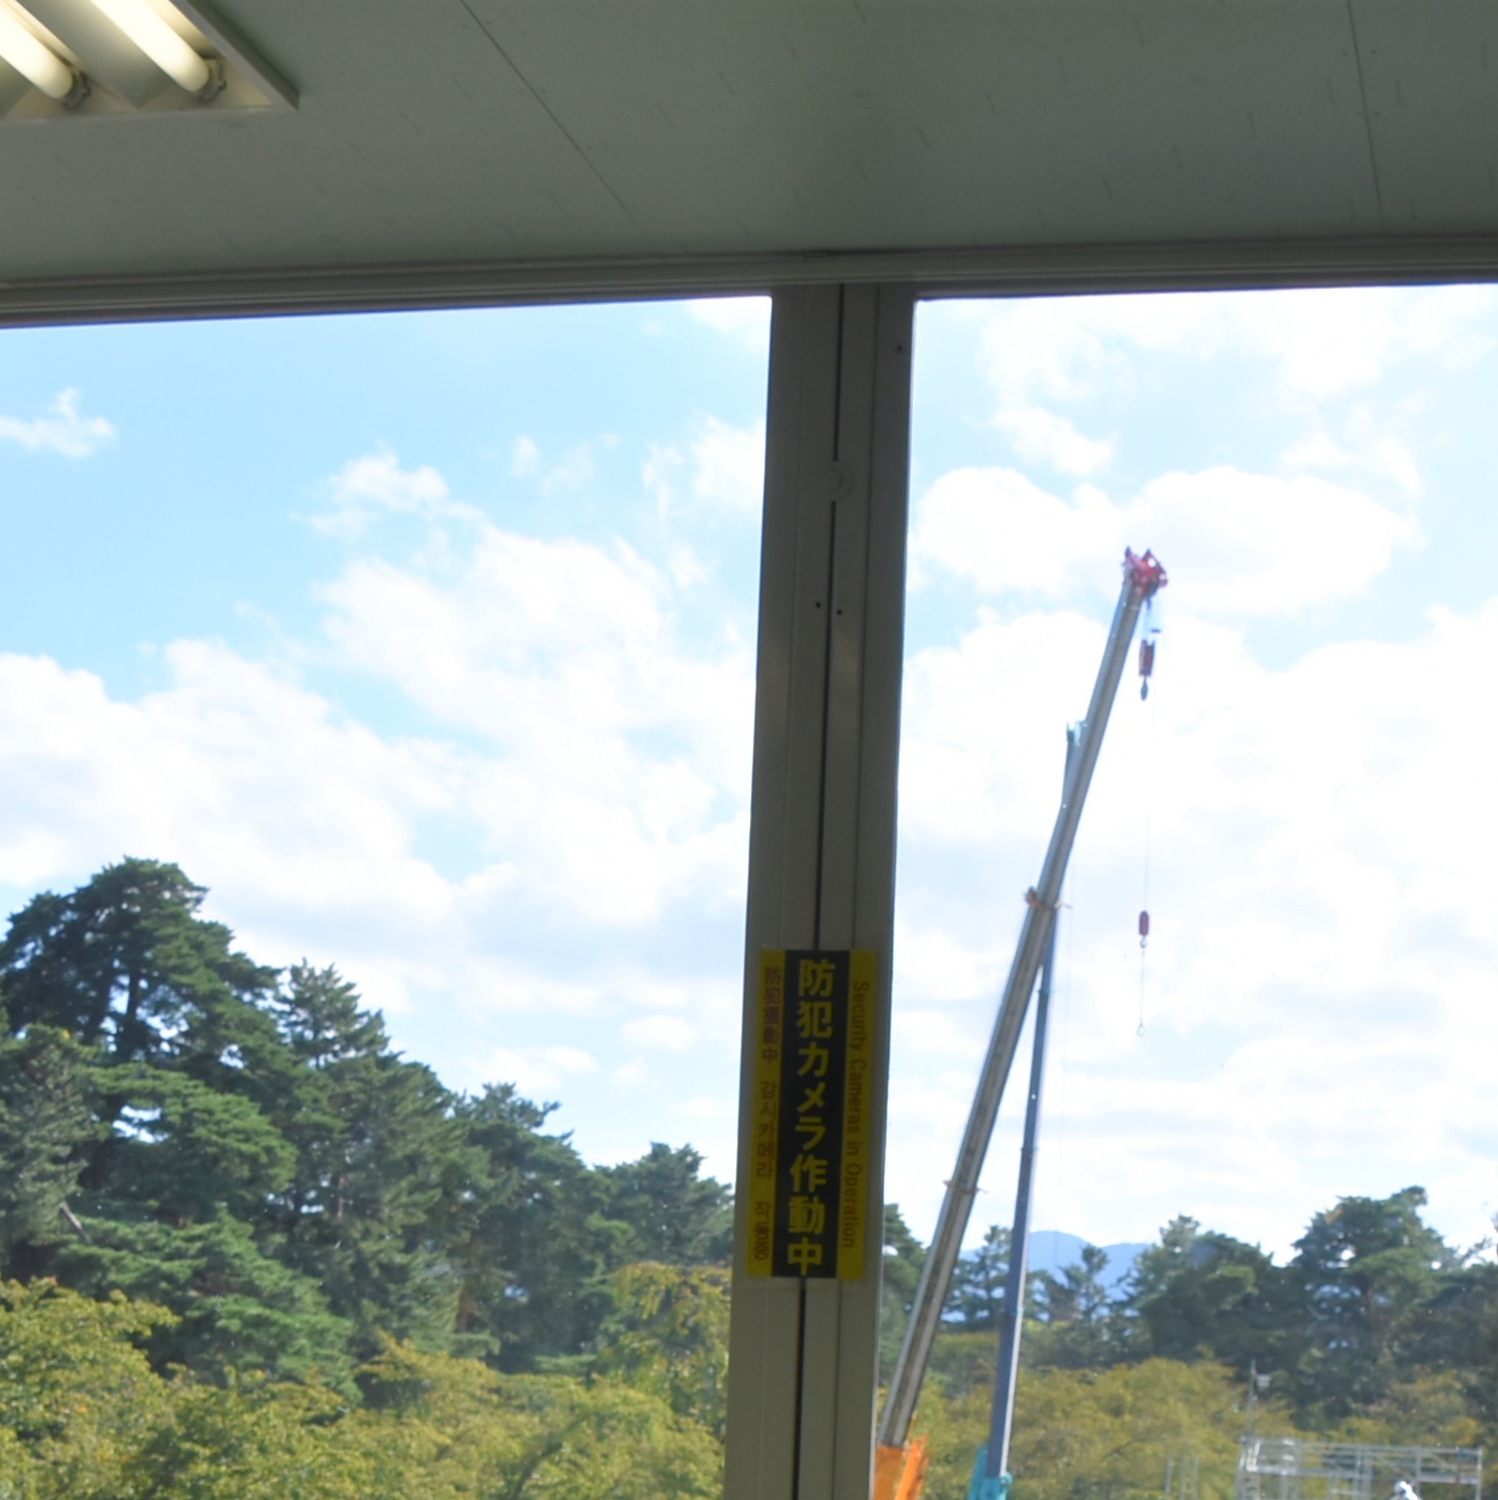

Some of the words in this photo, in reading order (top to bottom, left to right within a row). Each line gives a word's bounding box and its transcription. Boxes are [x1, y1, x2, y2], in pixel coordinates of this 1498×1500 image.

[849, 980, 870, 1051] Security
[787, 959, 836, 1276] 防犯カメラ作動中
[847, 1059, 867, 1135] Cameras
[845, 1141, 862, 1153] in
[840, 1163, 862, 1249] Operation
